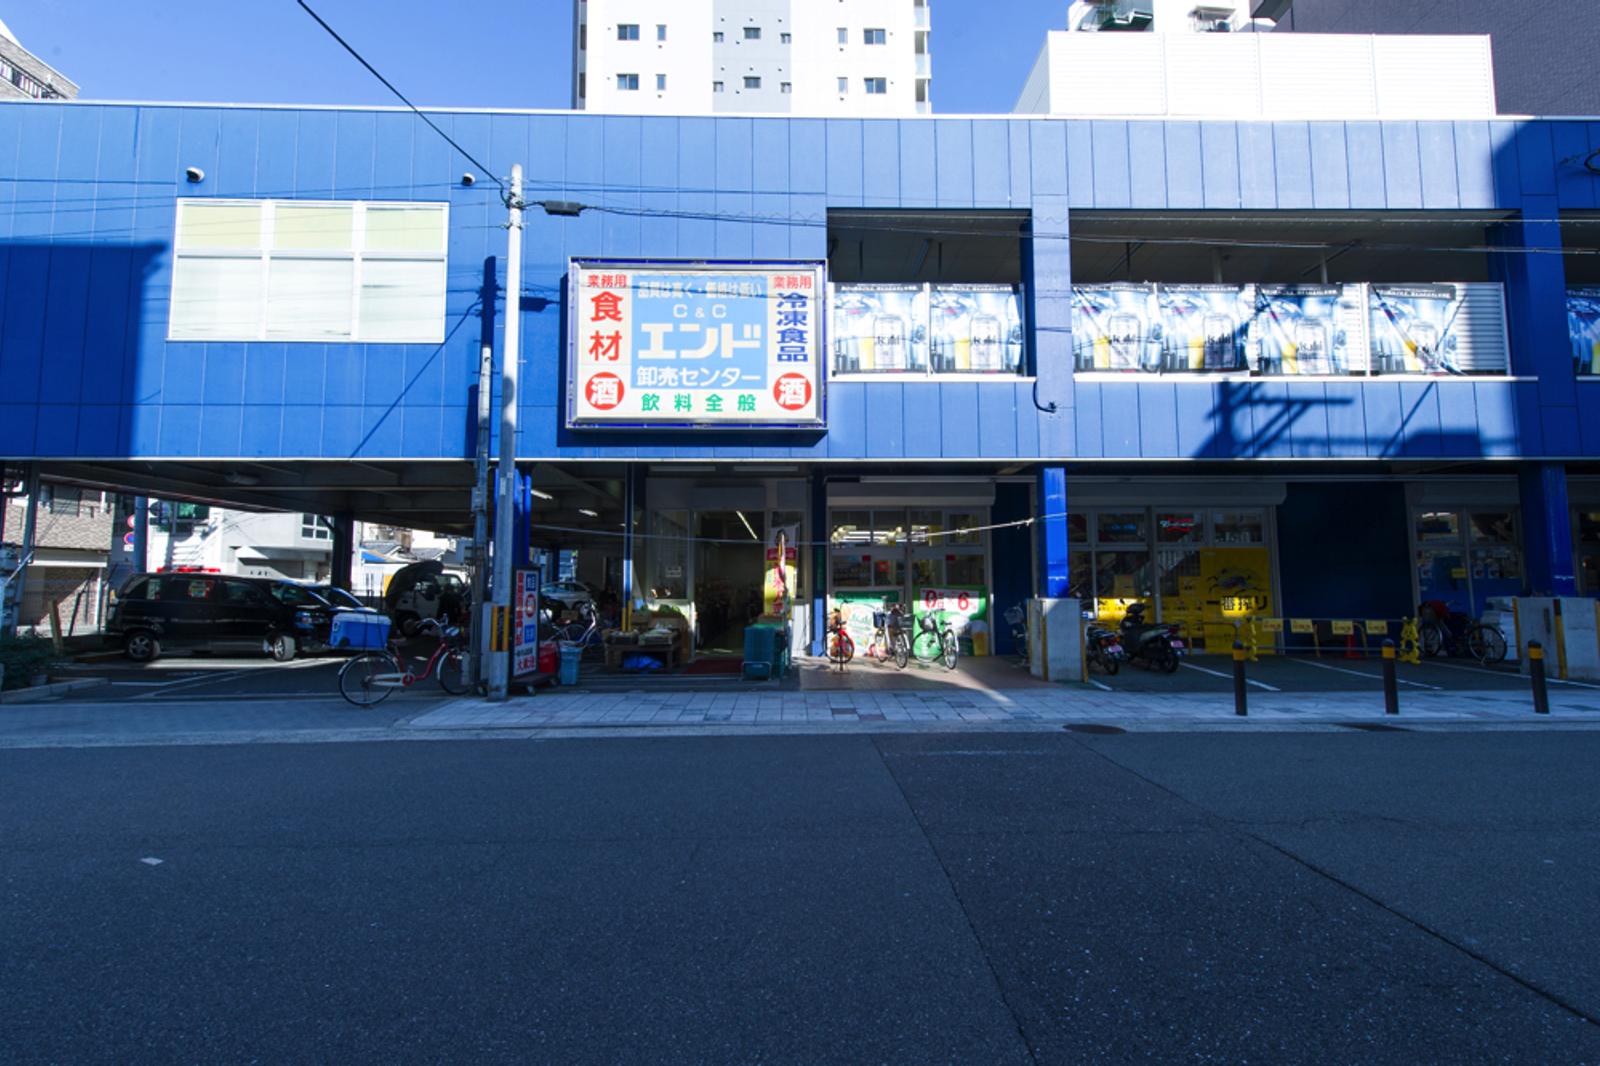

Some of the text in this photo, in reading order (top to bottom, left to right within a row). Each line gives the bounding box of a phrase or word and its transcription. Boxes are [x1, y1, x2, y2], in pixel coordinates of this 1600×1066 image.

[587, 274, 628, 289] 業務用
[773, 275, 812, 290] 業務用
[588, 291, 624, 362] 食材
[776, 292, 809, 363] 冷凍食品
[637, 323, 761, 360] エンド
[590, 377, 621, 406] 酒
[636, 366, 761, 388] 卸売センター
[776, 377, 808, 406] 酒
[641, 393, 757, 412] 飲料全般
